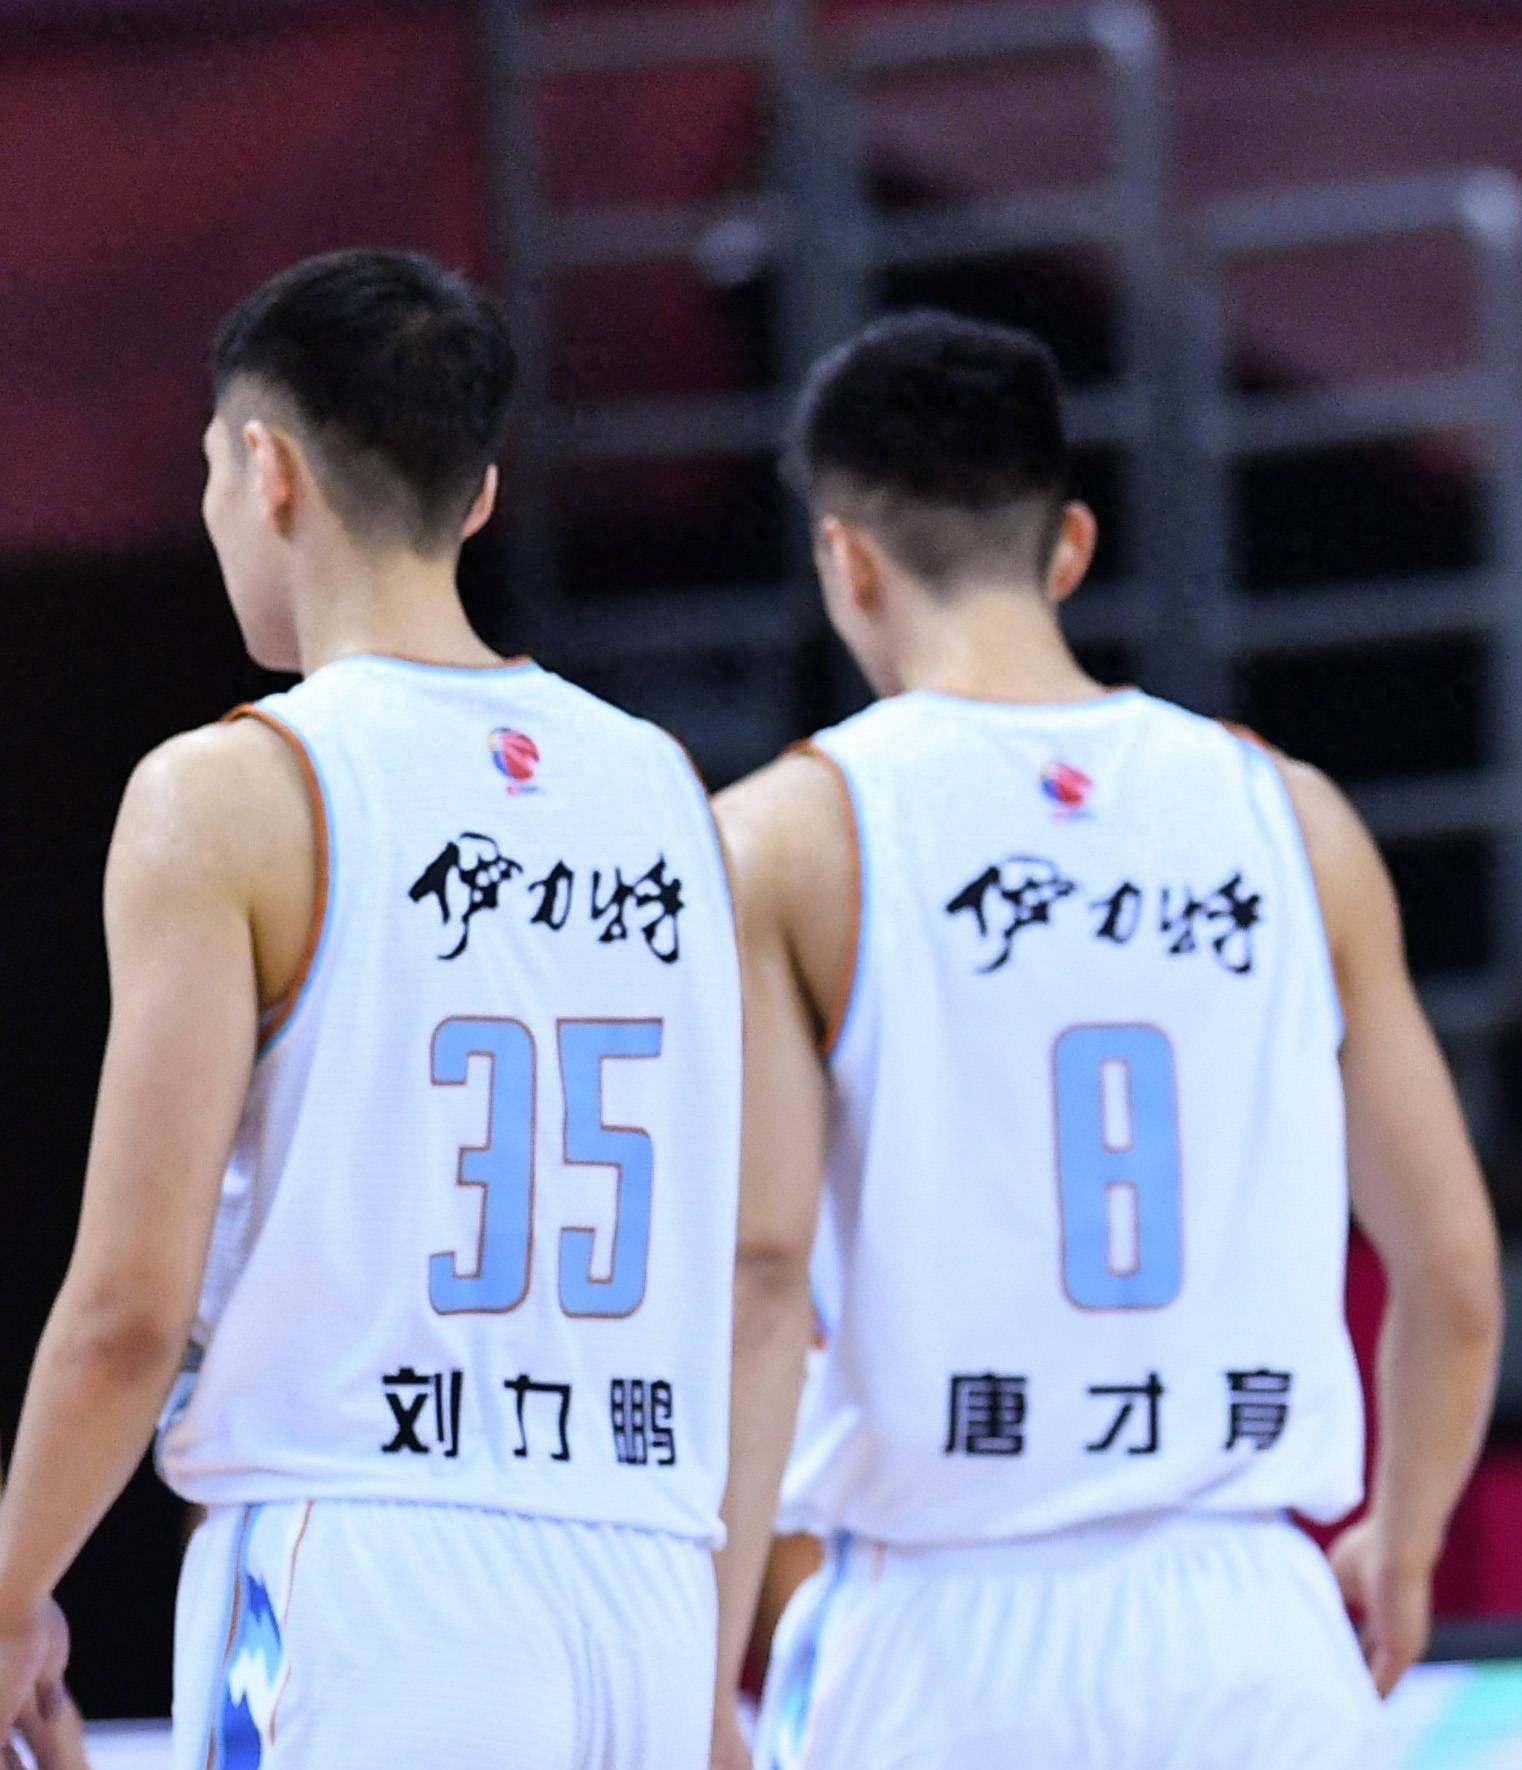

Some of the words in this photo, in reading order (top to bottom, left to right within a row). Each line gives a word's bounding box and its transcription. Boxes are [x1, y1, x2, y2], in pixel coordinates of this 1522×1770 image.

[408, 832, 684, 963] 伊力特
[946, 853, 1262, 974] 伊力特
[429, 1015, 663, 1318] 35
[1052, 1023, 1184, 1312] 8
[381, 1367, 676, 1465] 刘力鹏
[945, 1369, 1292, 1456] 唐才育
